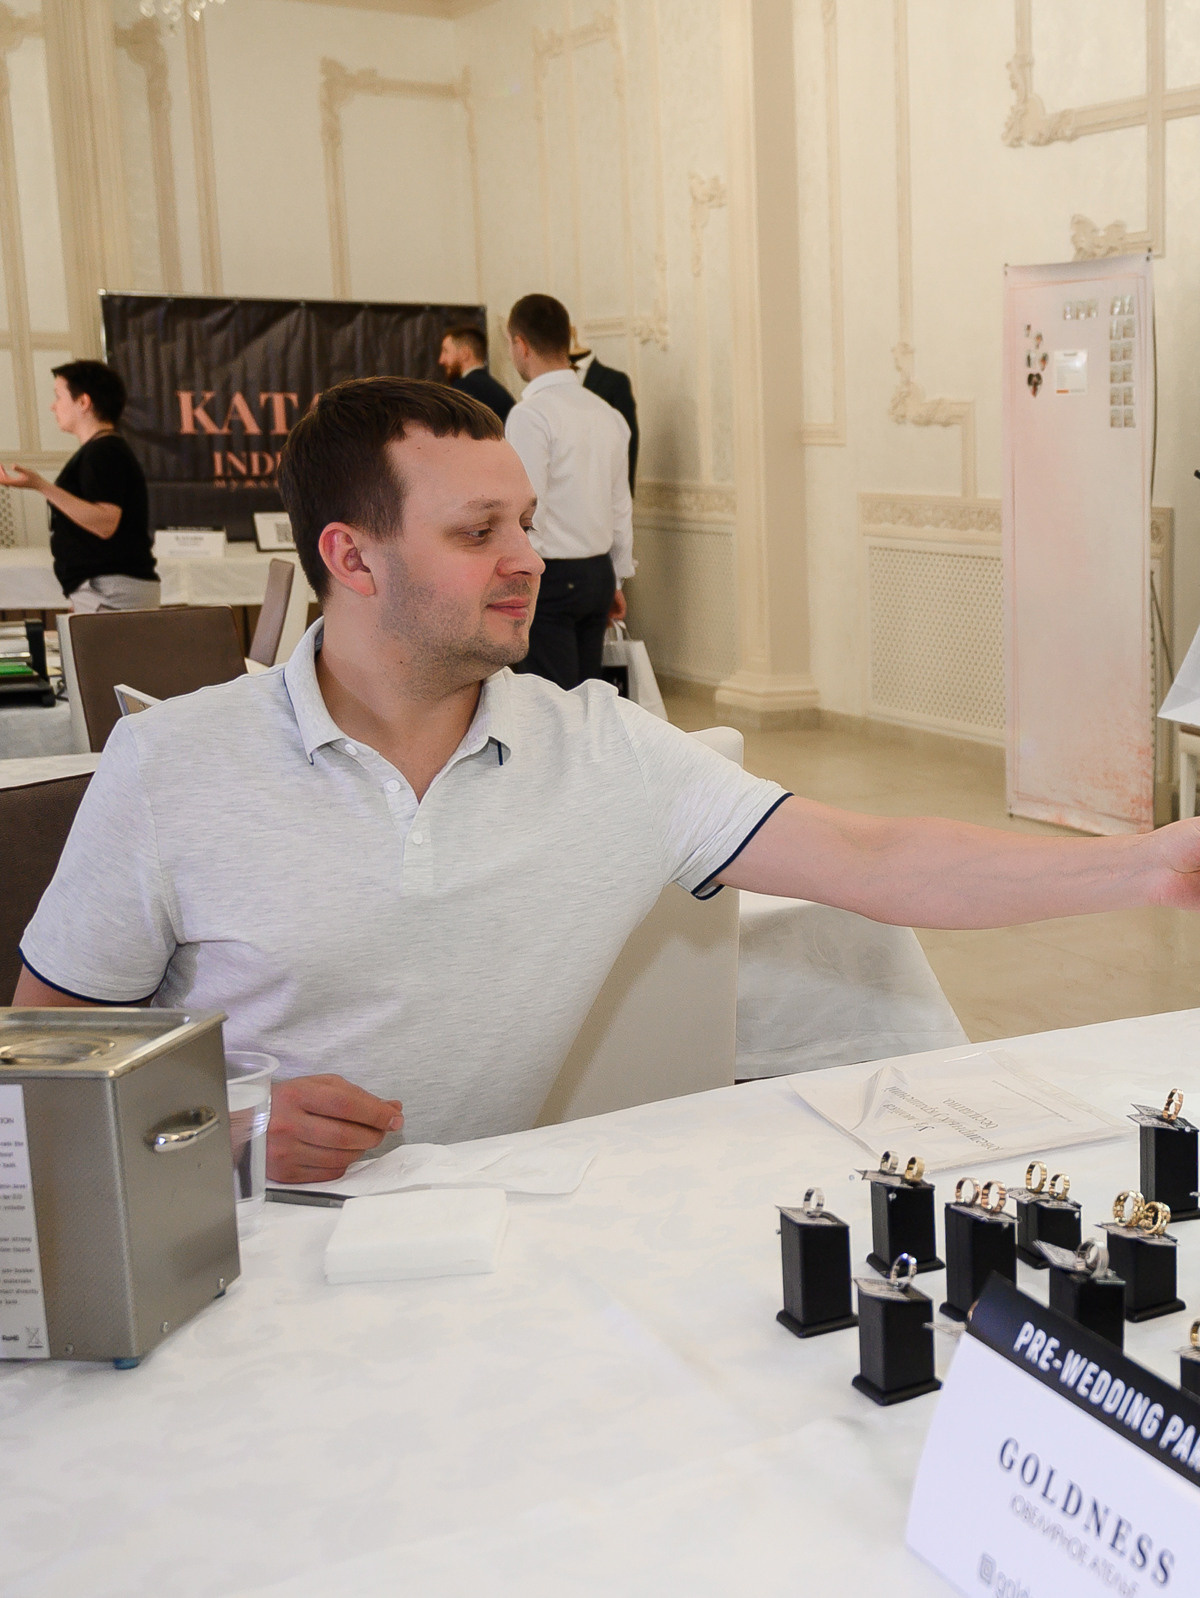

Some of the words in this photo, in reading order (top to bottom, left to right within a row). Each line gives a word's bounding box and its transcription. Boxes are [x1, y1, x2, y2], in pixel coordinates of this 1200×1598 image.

[176, 390, 320, 435] KAT
[1013, 1320, 1165, 1440] PRE-WEDDING
[998, 1436, 1176, 1587] GOLDNESS
